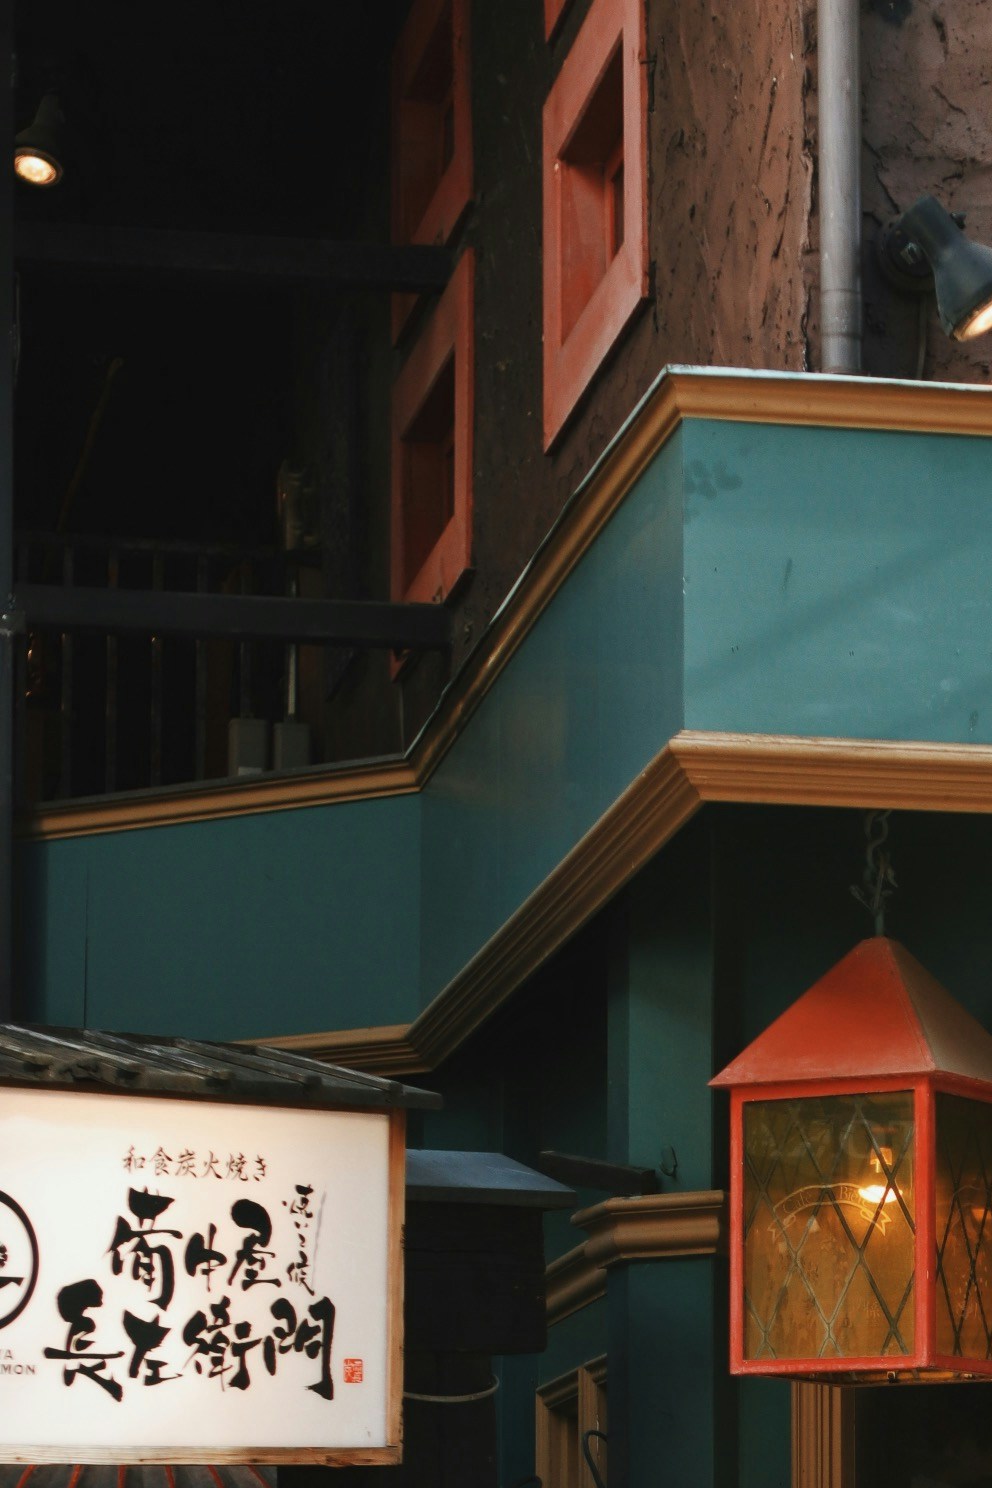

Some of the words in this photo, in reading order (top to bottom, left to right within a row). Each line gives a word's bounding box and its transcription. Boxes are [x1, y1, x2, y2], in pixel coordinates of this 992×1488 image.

[122, 1145, 270, 1182] 和食炭火焼き
